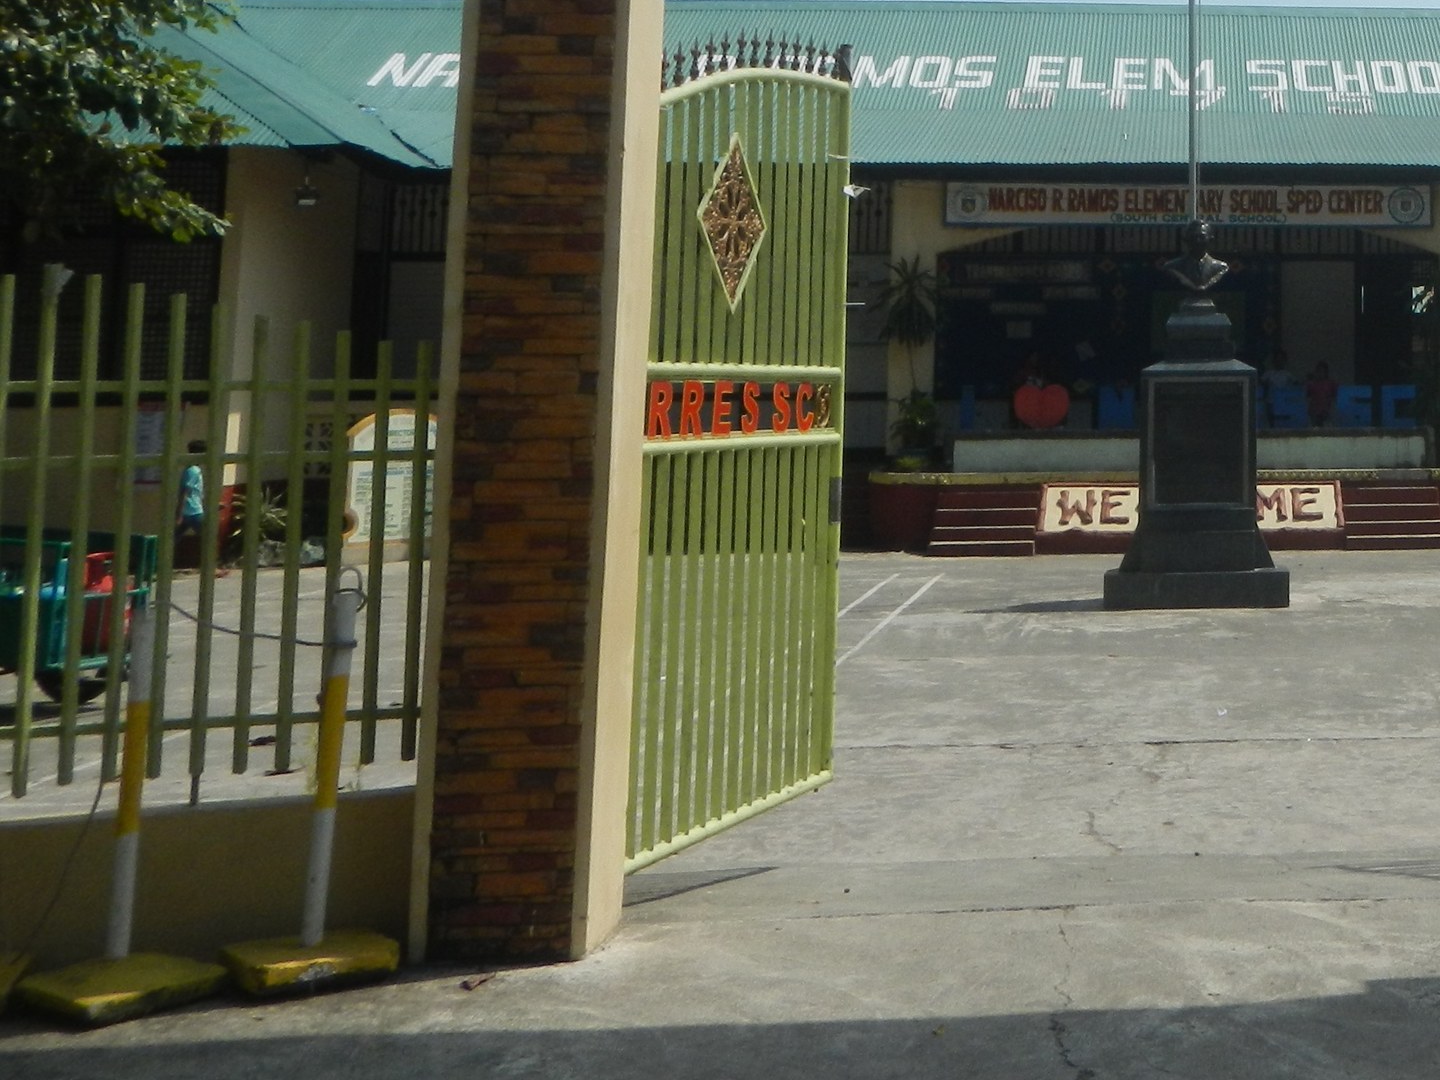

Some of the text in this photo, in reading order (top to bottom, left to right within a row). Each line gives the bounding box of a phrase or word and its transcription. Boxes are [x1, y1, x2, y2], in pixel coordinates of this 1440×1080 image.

[986, 186, 1047, 213] NARCISO
[1067, 188, 1120, 213] RAMOS
[1124, 189, 1224, 214] ELEMENARY
[1229, 189, 1282, 215] SCHOOL
[1286, 189, 1323, 215] SPED
[1326, 189, 1385, 216] CENTER
[1162, 213, 1224, 224] CENRAL
[1230, 213, 1287, 224] SCHOOL)
[1055, 486, 1324, 527] WEME
